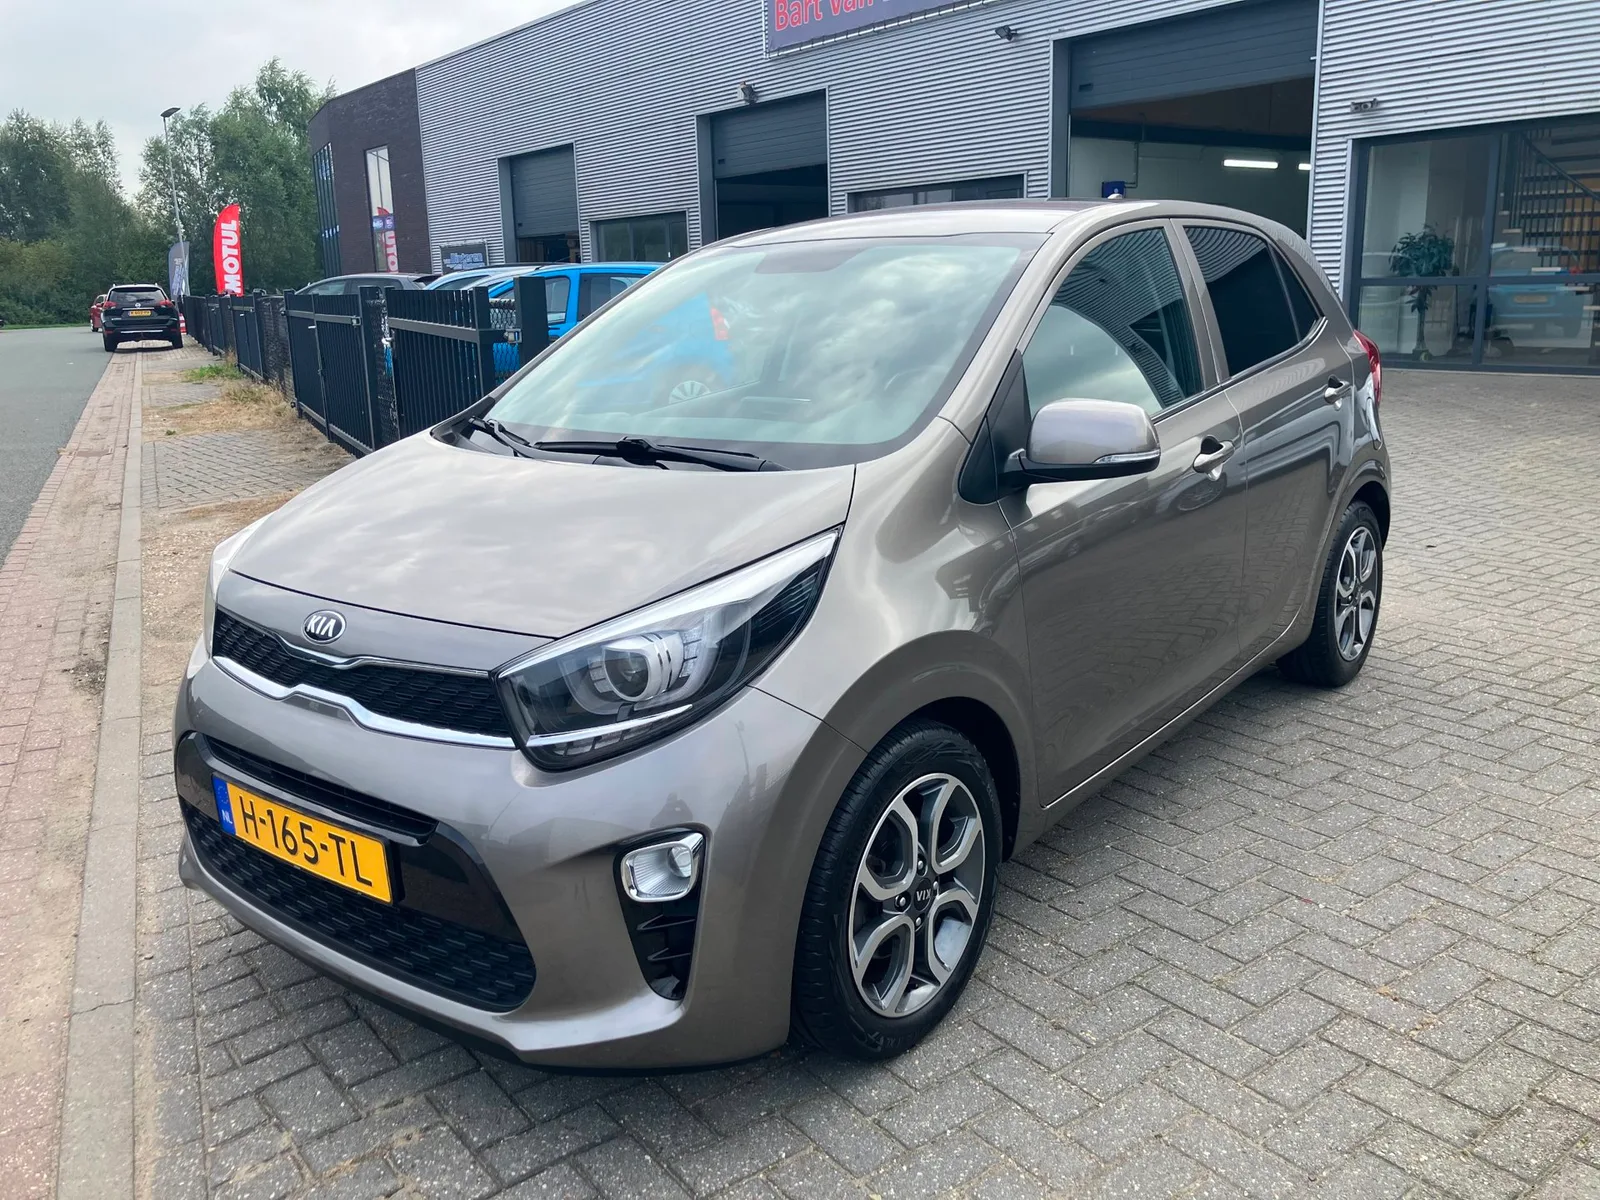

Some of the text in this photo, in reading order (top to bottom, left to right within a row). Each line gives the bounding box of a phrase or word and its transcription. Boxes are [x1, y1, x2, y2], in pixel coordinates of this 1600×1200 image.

[221, 220, 242, 293] MOTUL
[306, 615, 336, 637] KIA
[221, 809, 233, 825] NL
[239, 795, 373, 887] H-165-TL
